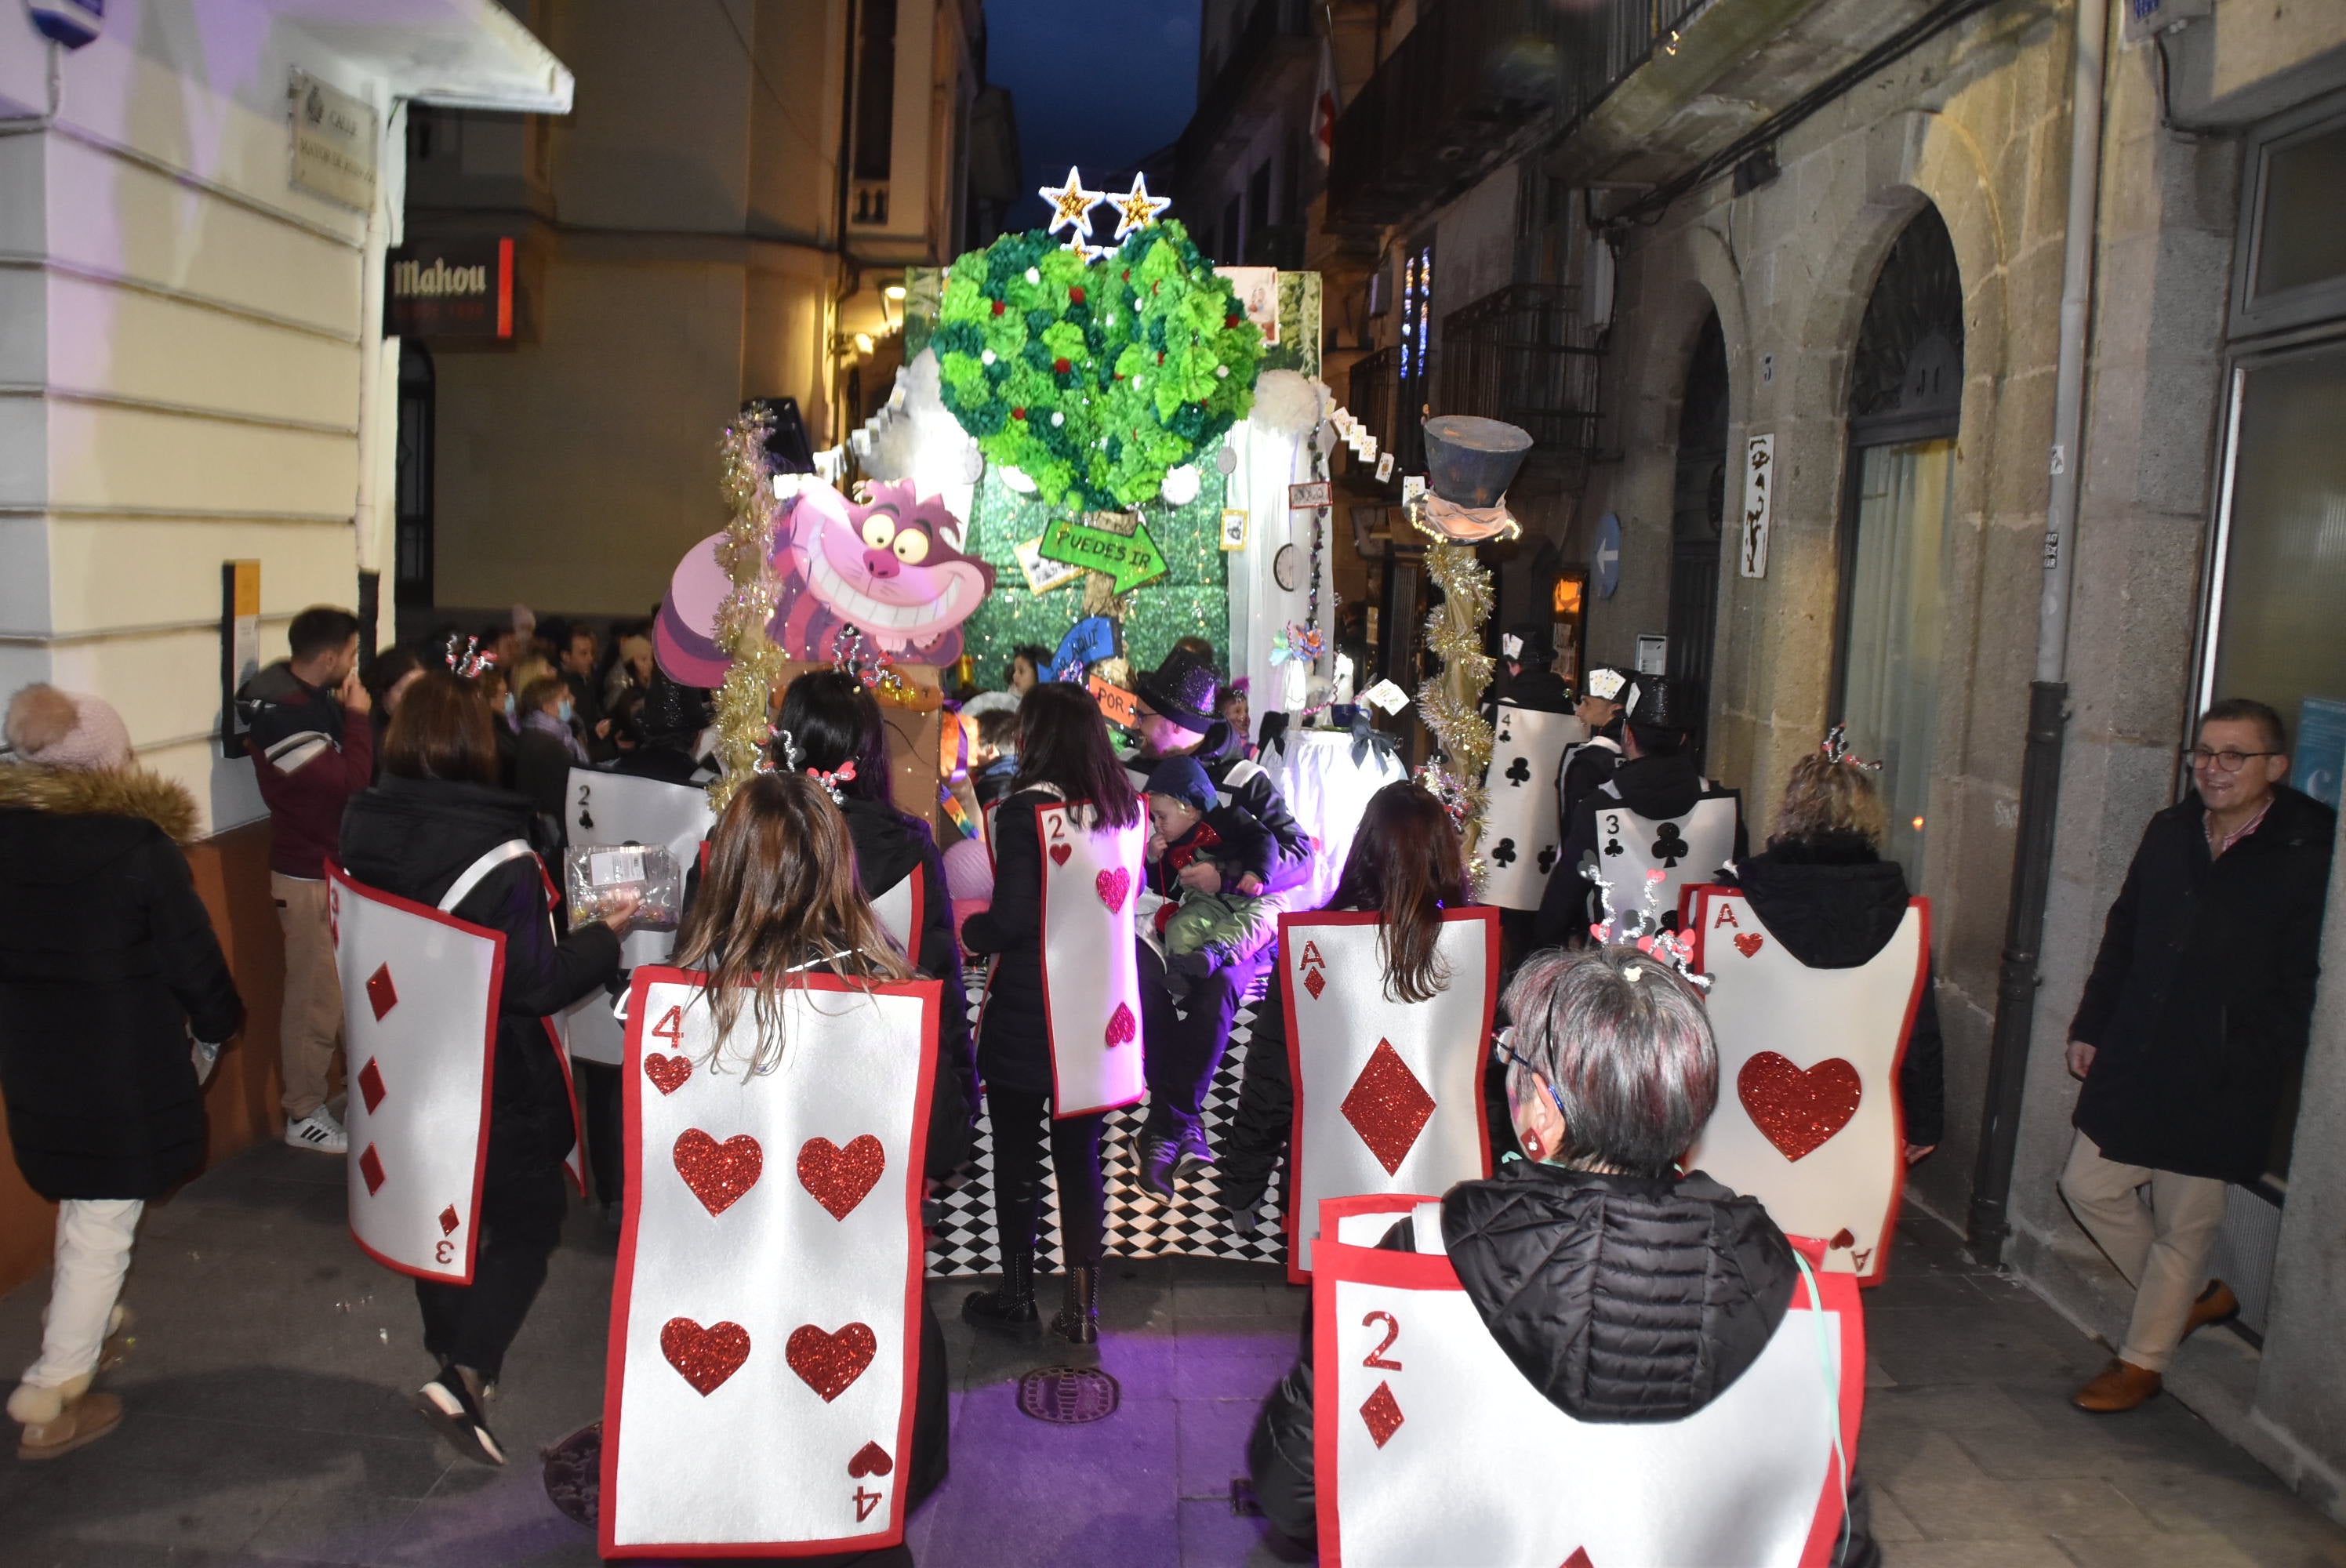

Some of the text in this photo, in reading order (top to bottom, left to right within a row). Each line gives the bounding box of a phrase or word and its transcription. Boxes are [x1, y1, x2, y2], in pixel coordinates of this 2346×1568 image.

[394, 256, 486, 297] Mahou
[1057, 529, 1152, 569] PUEDES IR
[1098, 687, 1124, 713] POR
[1502, 713, 1511, 727] 4
[578, 785, 591, 807] 2
[1048, 813, 1066, 839] 2
[1605, 814, 1621, 835] 3
[1714, 902, 1739, 929] A
[1299, 940, 1325, 972] A
[652, 1004, 685, 1049] 4
[435, 1240, 455, 1265] 3
[1850, 1247, 1872, 1272] A
[1360, 1309, 1403, 1373] 2
[852, 1486, 883, 1523] 4
